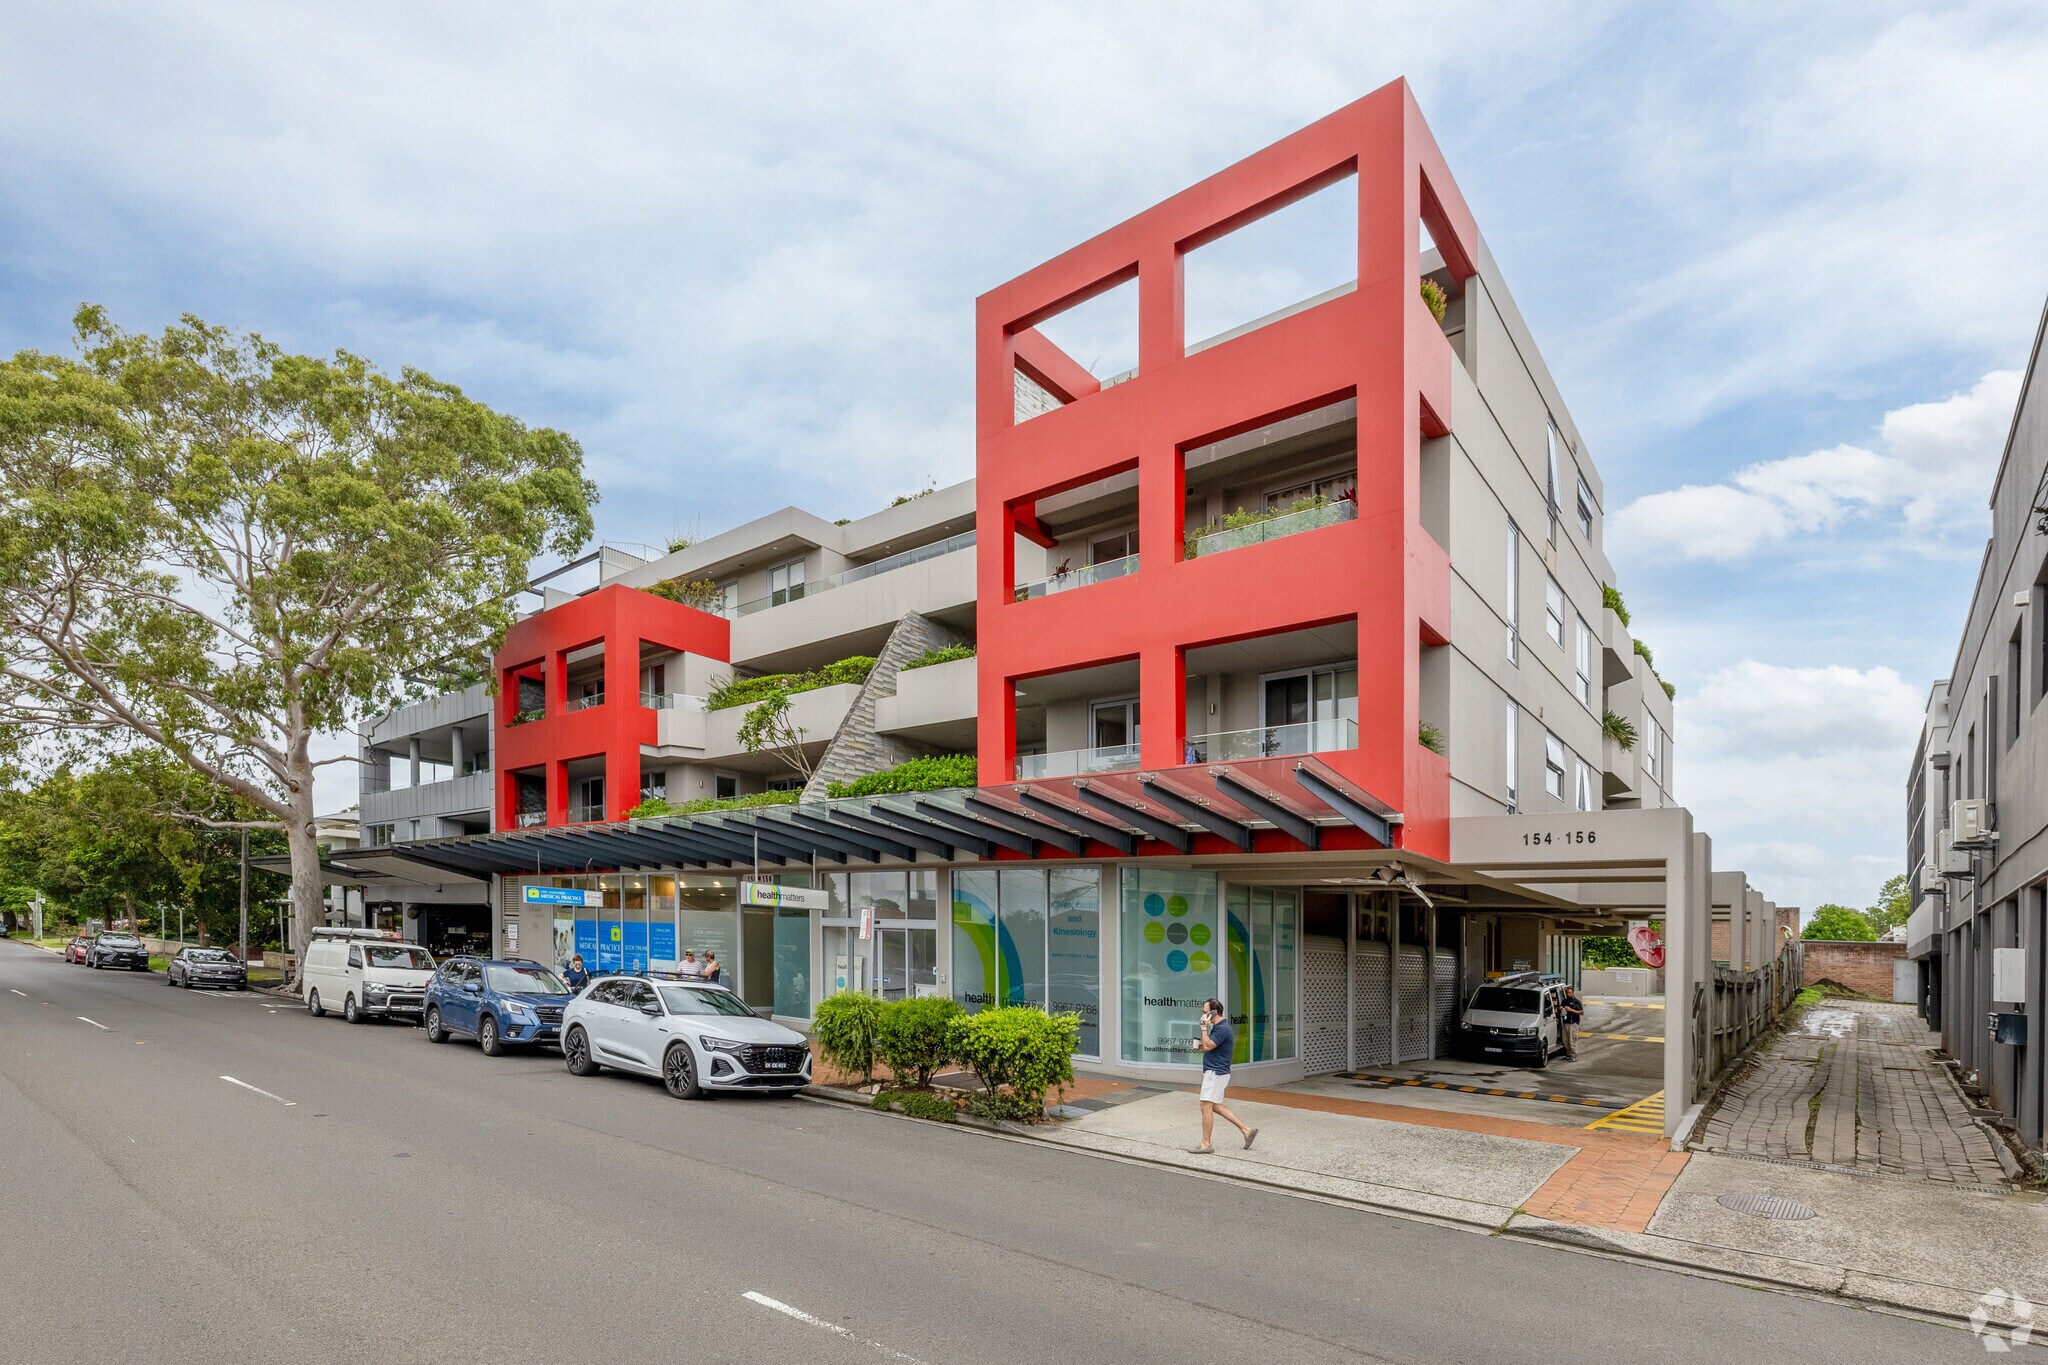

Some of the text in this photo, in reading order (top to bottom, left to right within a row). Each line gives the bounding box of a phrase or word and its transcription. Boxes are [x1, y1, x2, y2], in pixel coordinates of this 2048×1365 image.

[1523, 831, 1596, 846] 154 156
[762, 875, 773, 883] 156
[757, 889, 805, 903] healthmatters
[1067, 914, 1082, 923] and
[1053, 927, 1096, 938] Kinesiology
[1052, 1001, 1097, 1015] 9967 9768
[1178, 1038, 1193, 1046] 976
